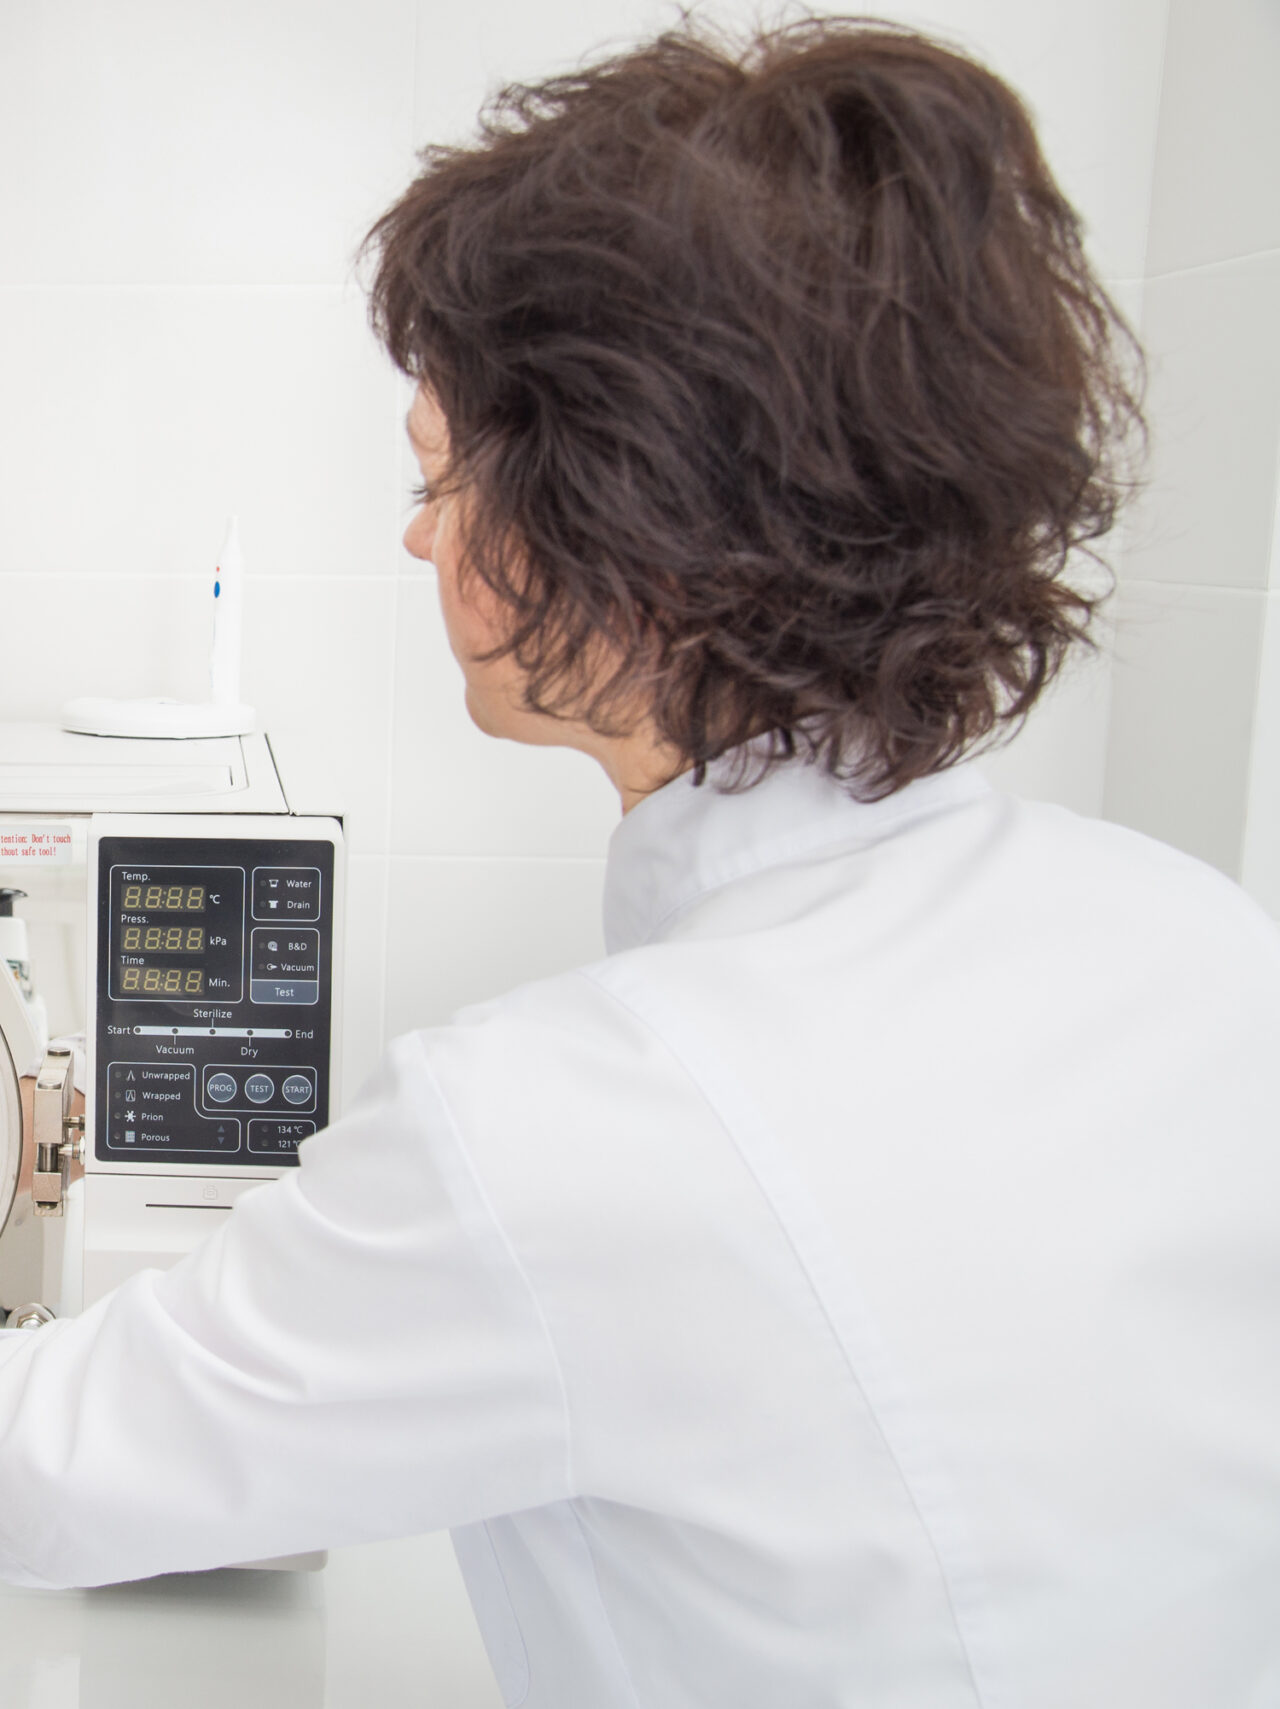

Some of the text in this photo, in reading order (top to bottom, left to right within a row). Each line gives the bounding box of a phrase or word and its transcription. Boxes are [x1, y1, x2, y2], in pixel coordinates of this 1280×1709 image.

[31, 833, 50, 844] Don't
[53, 833, 72, 844] touch
[21, 846, 36, 857] safe
[38, 846, 57, 857] tool!
[121, 870, 151, 883] Temp.
[285, 878, 312, 889] Water
[286, 900, 311, 910] Drain
[120, 914, 150, 924] Press.
[209, 935, 228, 947] kPa
[287, 942, 308, 951] B&D
[120, 955, 145, 966] Time
[280, 963, 315, 973] Vacuum
[208, 977, 231, 989] Min.
[274, 987, 295, 998] Test
[192, 1008, 233, 1019] Sterilize
[106, 1025, 132, 1035] Start
[295, 1029, 314, 1040] End
[155, 1045, 195, 1055] Vacuum
[240, 1046, 259, 1058] Dry
[141, 1071, 191, 1081] Unwrapped
[249, 1084, 269, 1093] TEST
[284, 1085, 310, 1094] START
[141, 1091, 181, 1101] Wrapped
[140, 1112, 164, 1122] Prion
[277, 1125, 292, 1134] 134
[140, 1133, 171, 1143] Porous
[277, 1140, 291, 1148] 121
